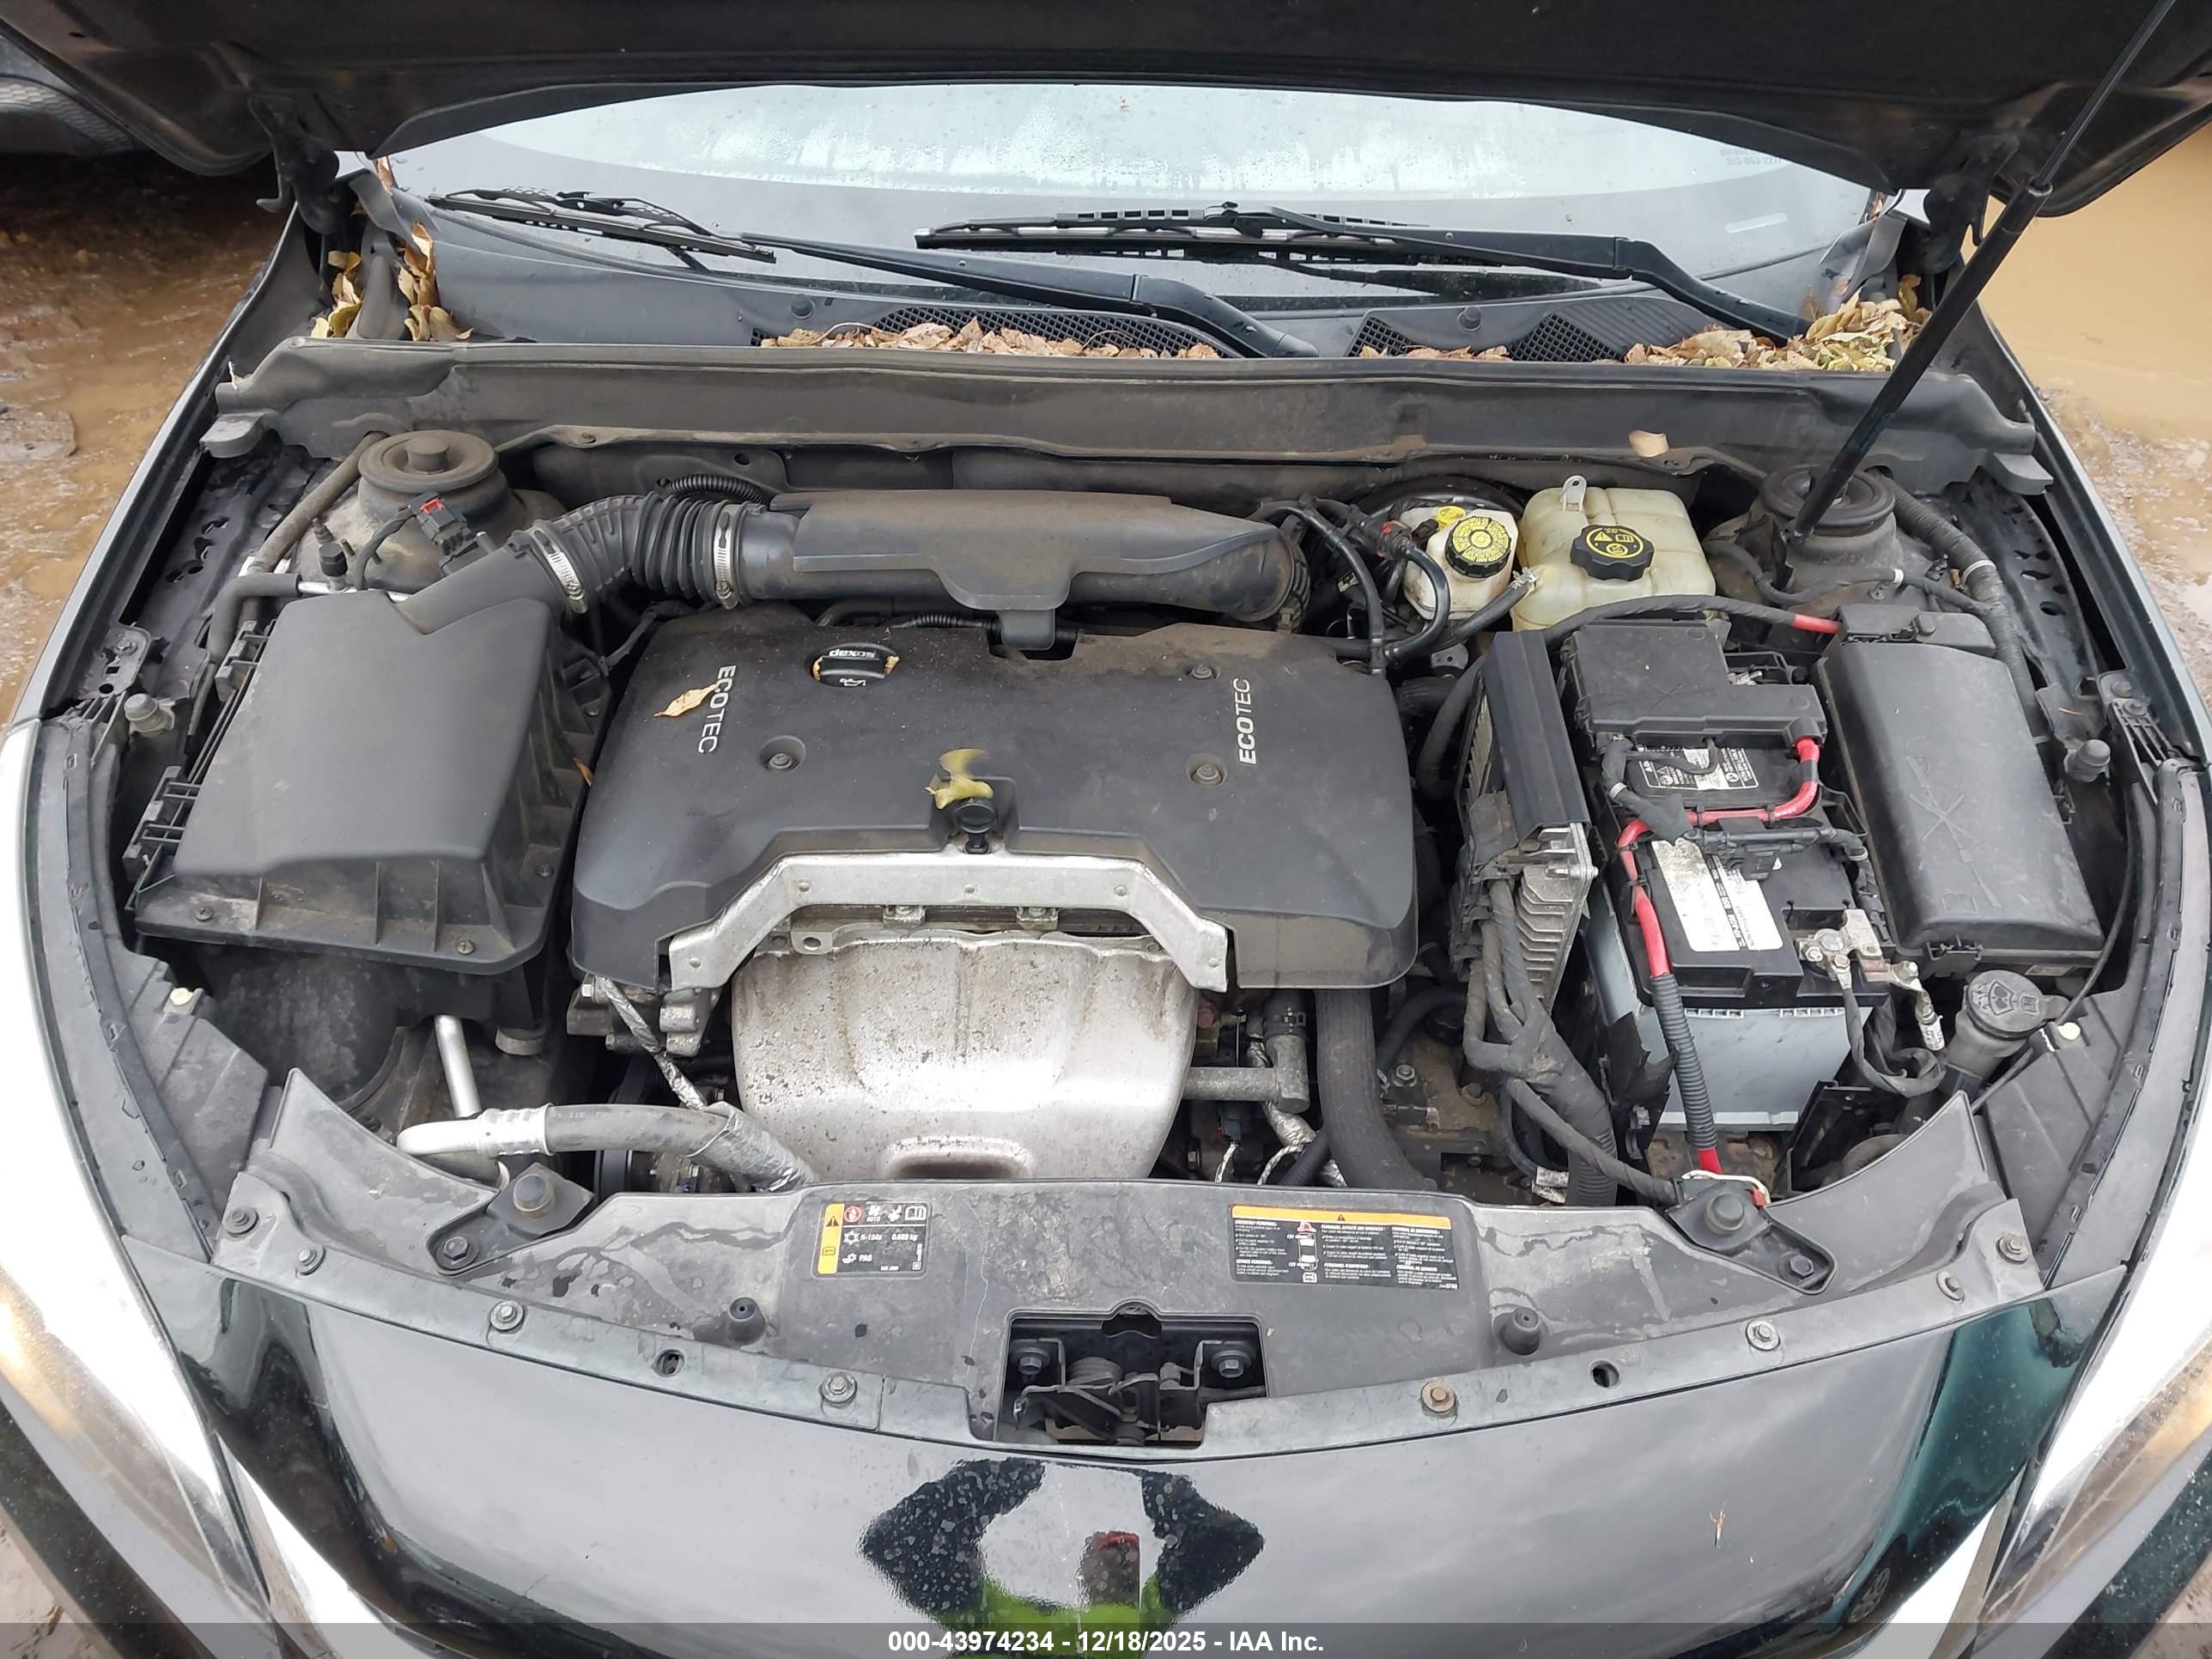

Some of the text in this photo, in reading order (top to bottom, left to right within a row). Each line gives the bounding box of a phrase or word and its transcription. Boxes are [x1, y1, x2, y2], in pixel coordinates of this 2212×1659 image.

[829, 648, 875, 659] dexos
[698, 665, 737, 753] ECOTEC
[1233, 678, 1256, 764] ECOTEC
[859, 1254, 872, 1262] PAG
